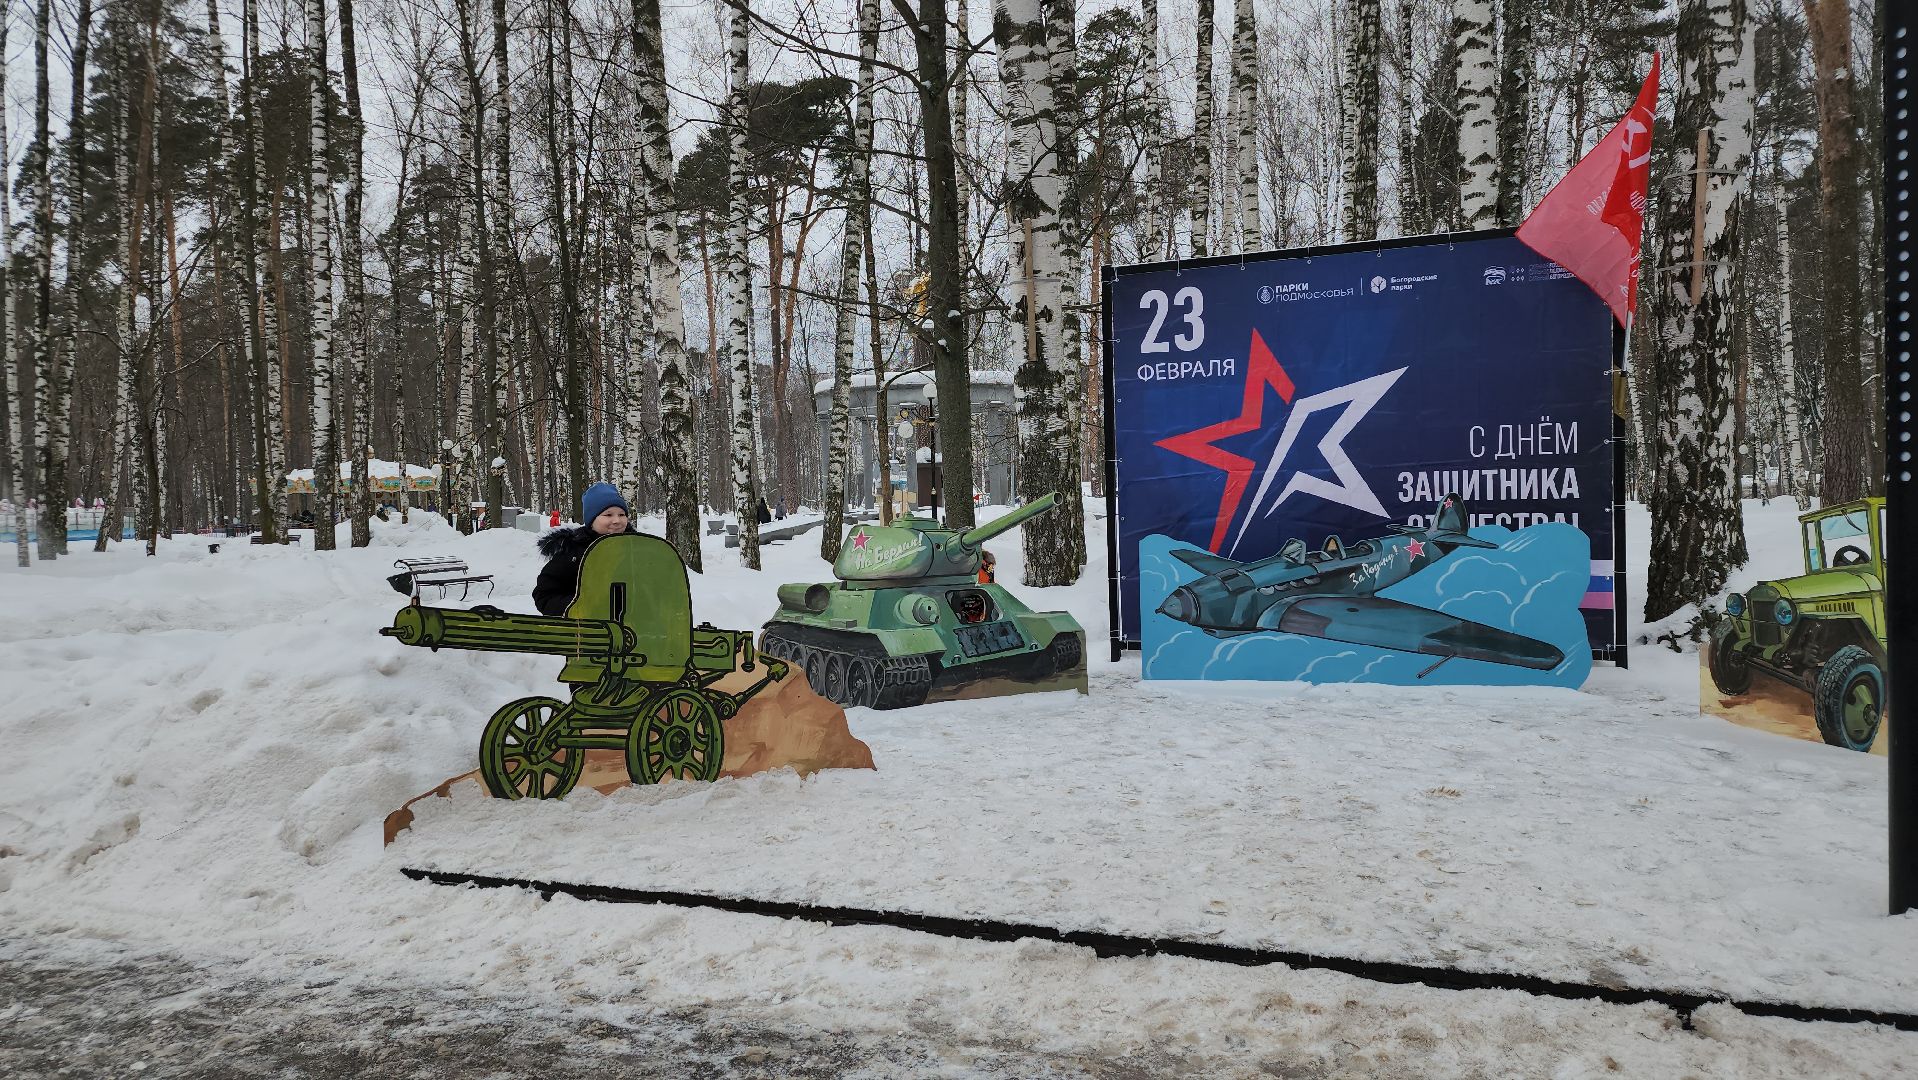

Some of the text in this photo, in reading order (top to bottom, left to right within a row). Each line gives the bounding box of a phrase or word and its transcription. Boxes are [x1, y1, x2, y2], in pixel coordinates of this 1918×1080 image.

[1275, 282, 1309, 294] ПАРКИ
[1275, 287, 1354, 302] ПОДМОСКОВЬЯ
[1390, 283, 1413, 292] парки
[1139, 286, 1205, 354] 23
[1137, 358, 1235, 382] ФЕВРАЛЯ
[1469, 415, 1579, 461] С ДНЁМ
[1397, 467, 1580, 503] ЗАЩИТНИКА
[874, 532, 925, 564] Берлин!
[1349, 572, 1366, 590] За
